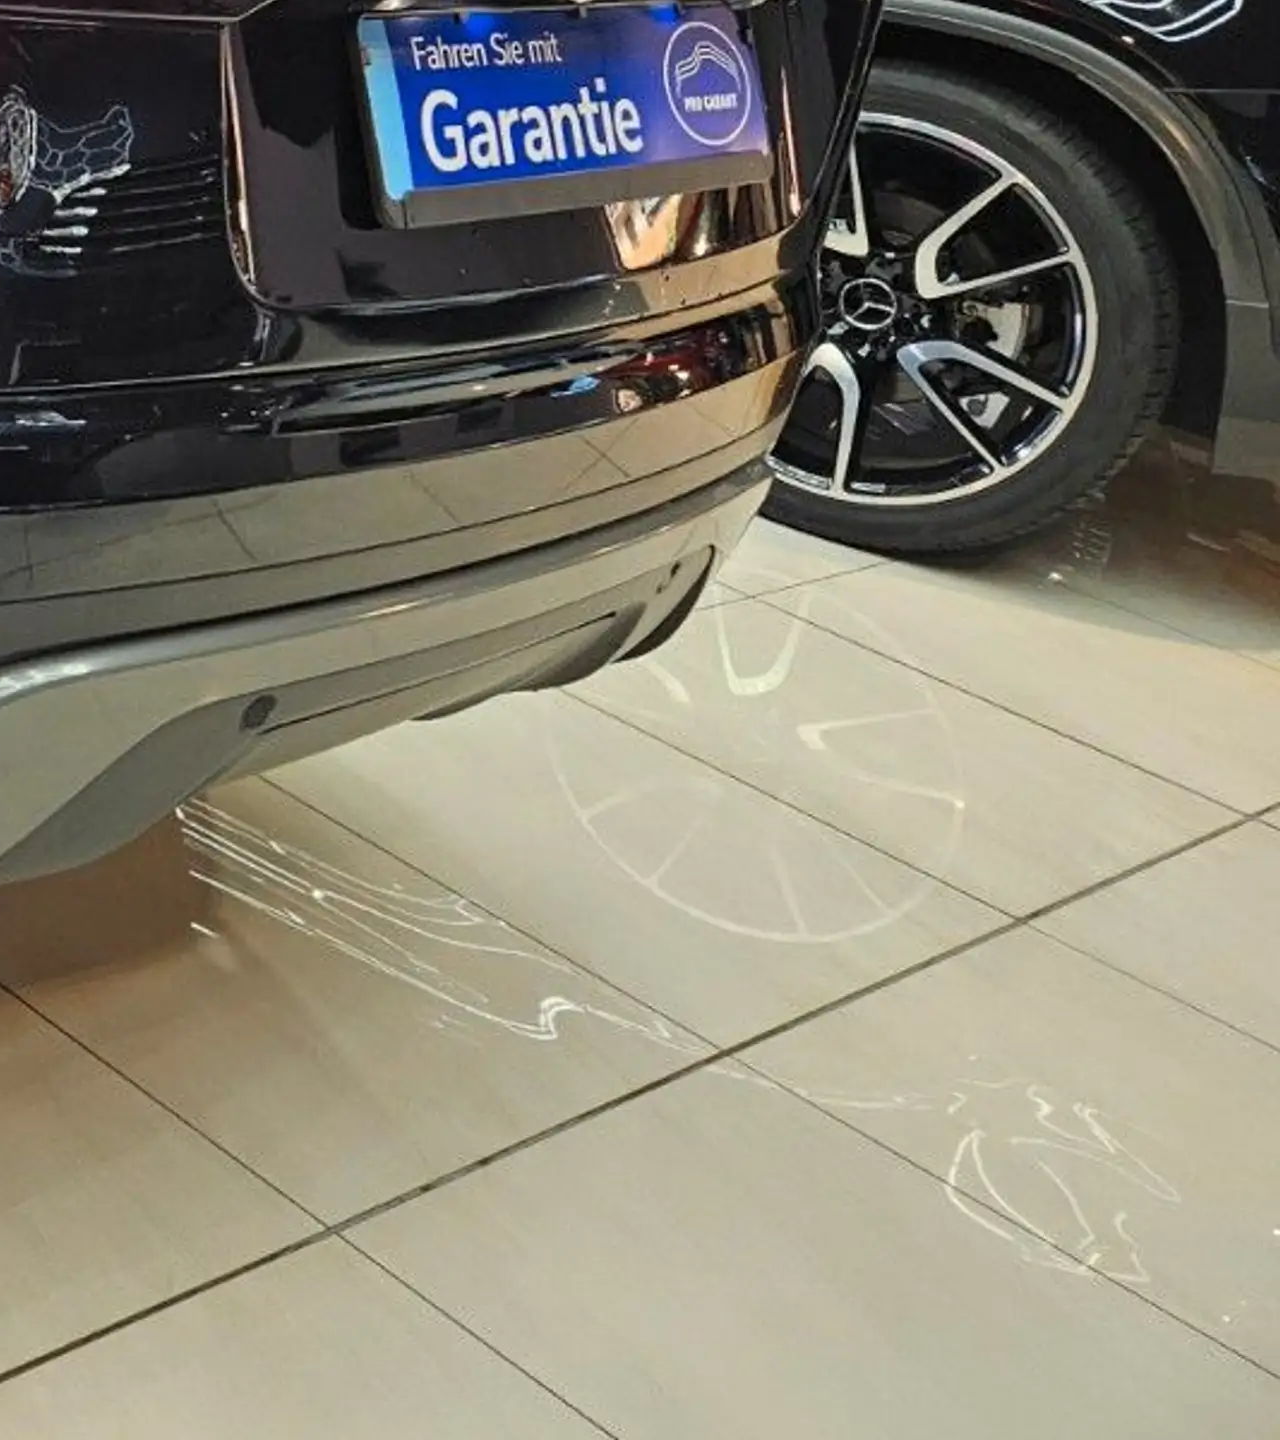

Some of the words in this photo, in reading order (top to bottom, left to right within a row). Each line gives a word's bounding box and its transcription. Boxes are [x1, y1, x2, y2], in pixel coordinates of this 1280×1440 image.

[410, 35, 489, 71] Fahren
[490, 32, 525, 66] Sie
[528, 30, 563, 64] mit
[420, 76, 645, 173] Garantie
